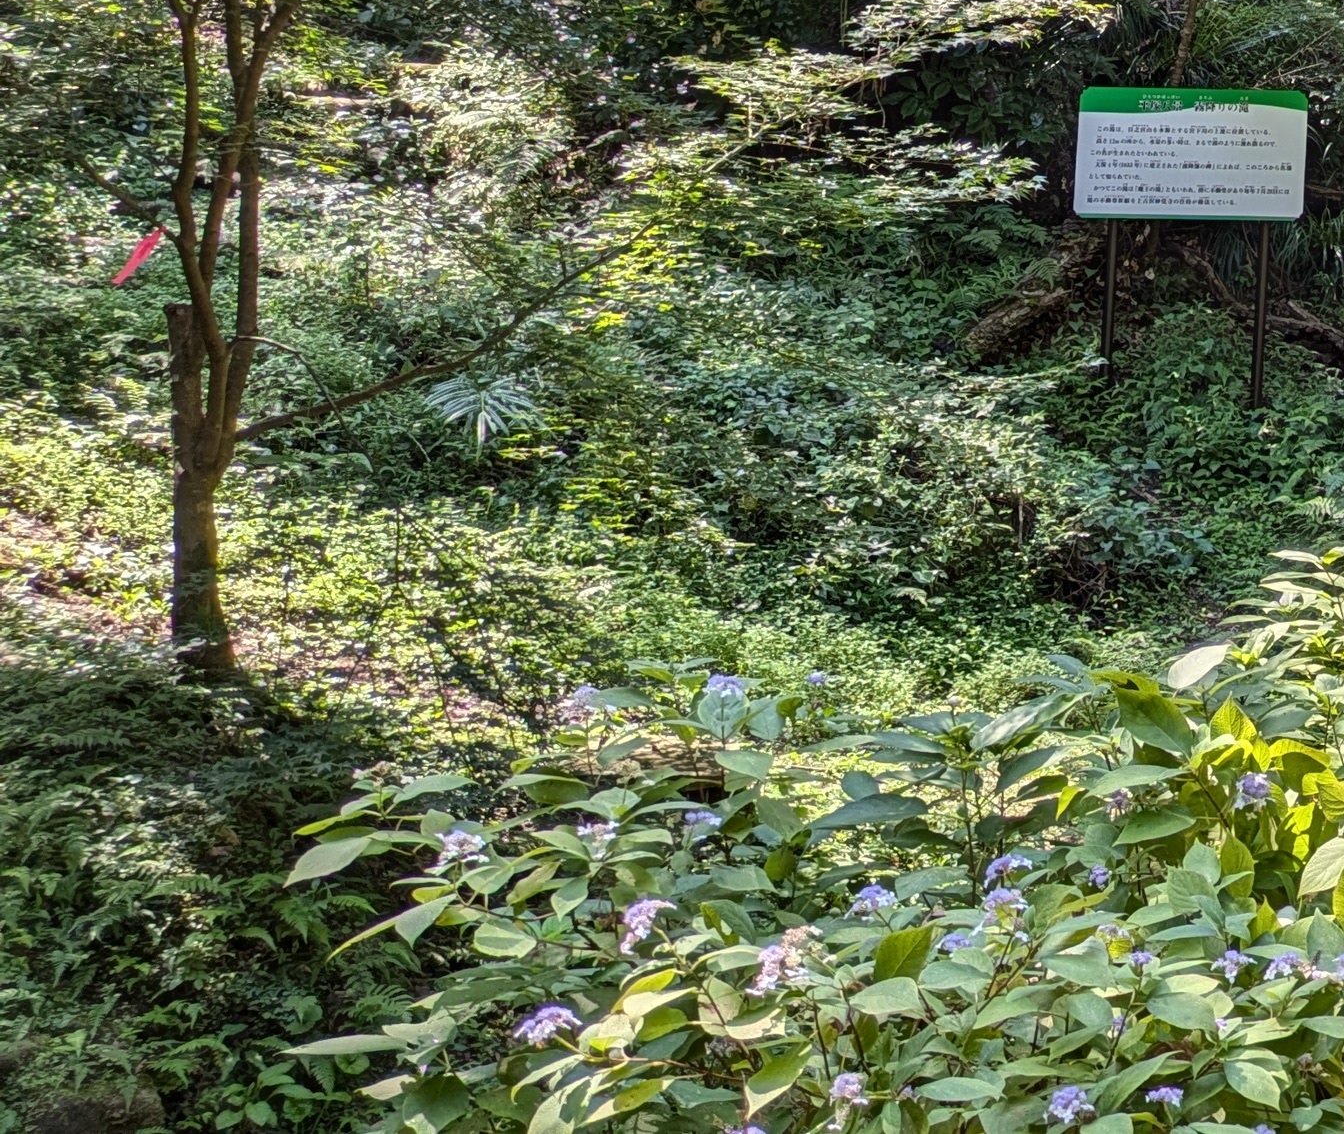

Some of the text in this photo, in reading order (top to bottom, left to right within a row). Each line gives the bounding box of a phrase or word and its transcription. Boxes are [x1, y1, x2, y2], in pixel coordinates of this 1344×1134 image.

[1138, 100, 1249, 113] 平塚八景 霧降りの滝
